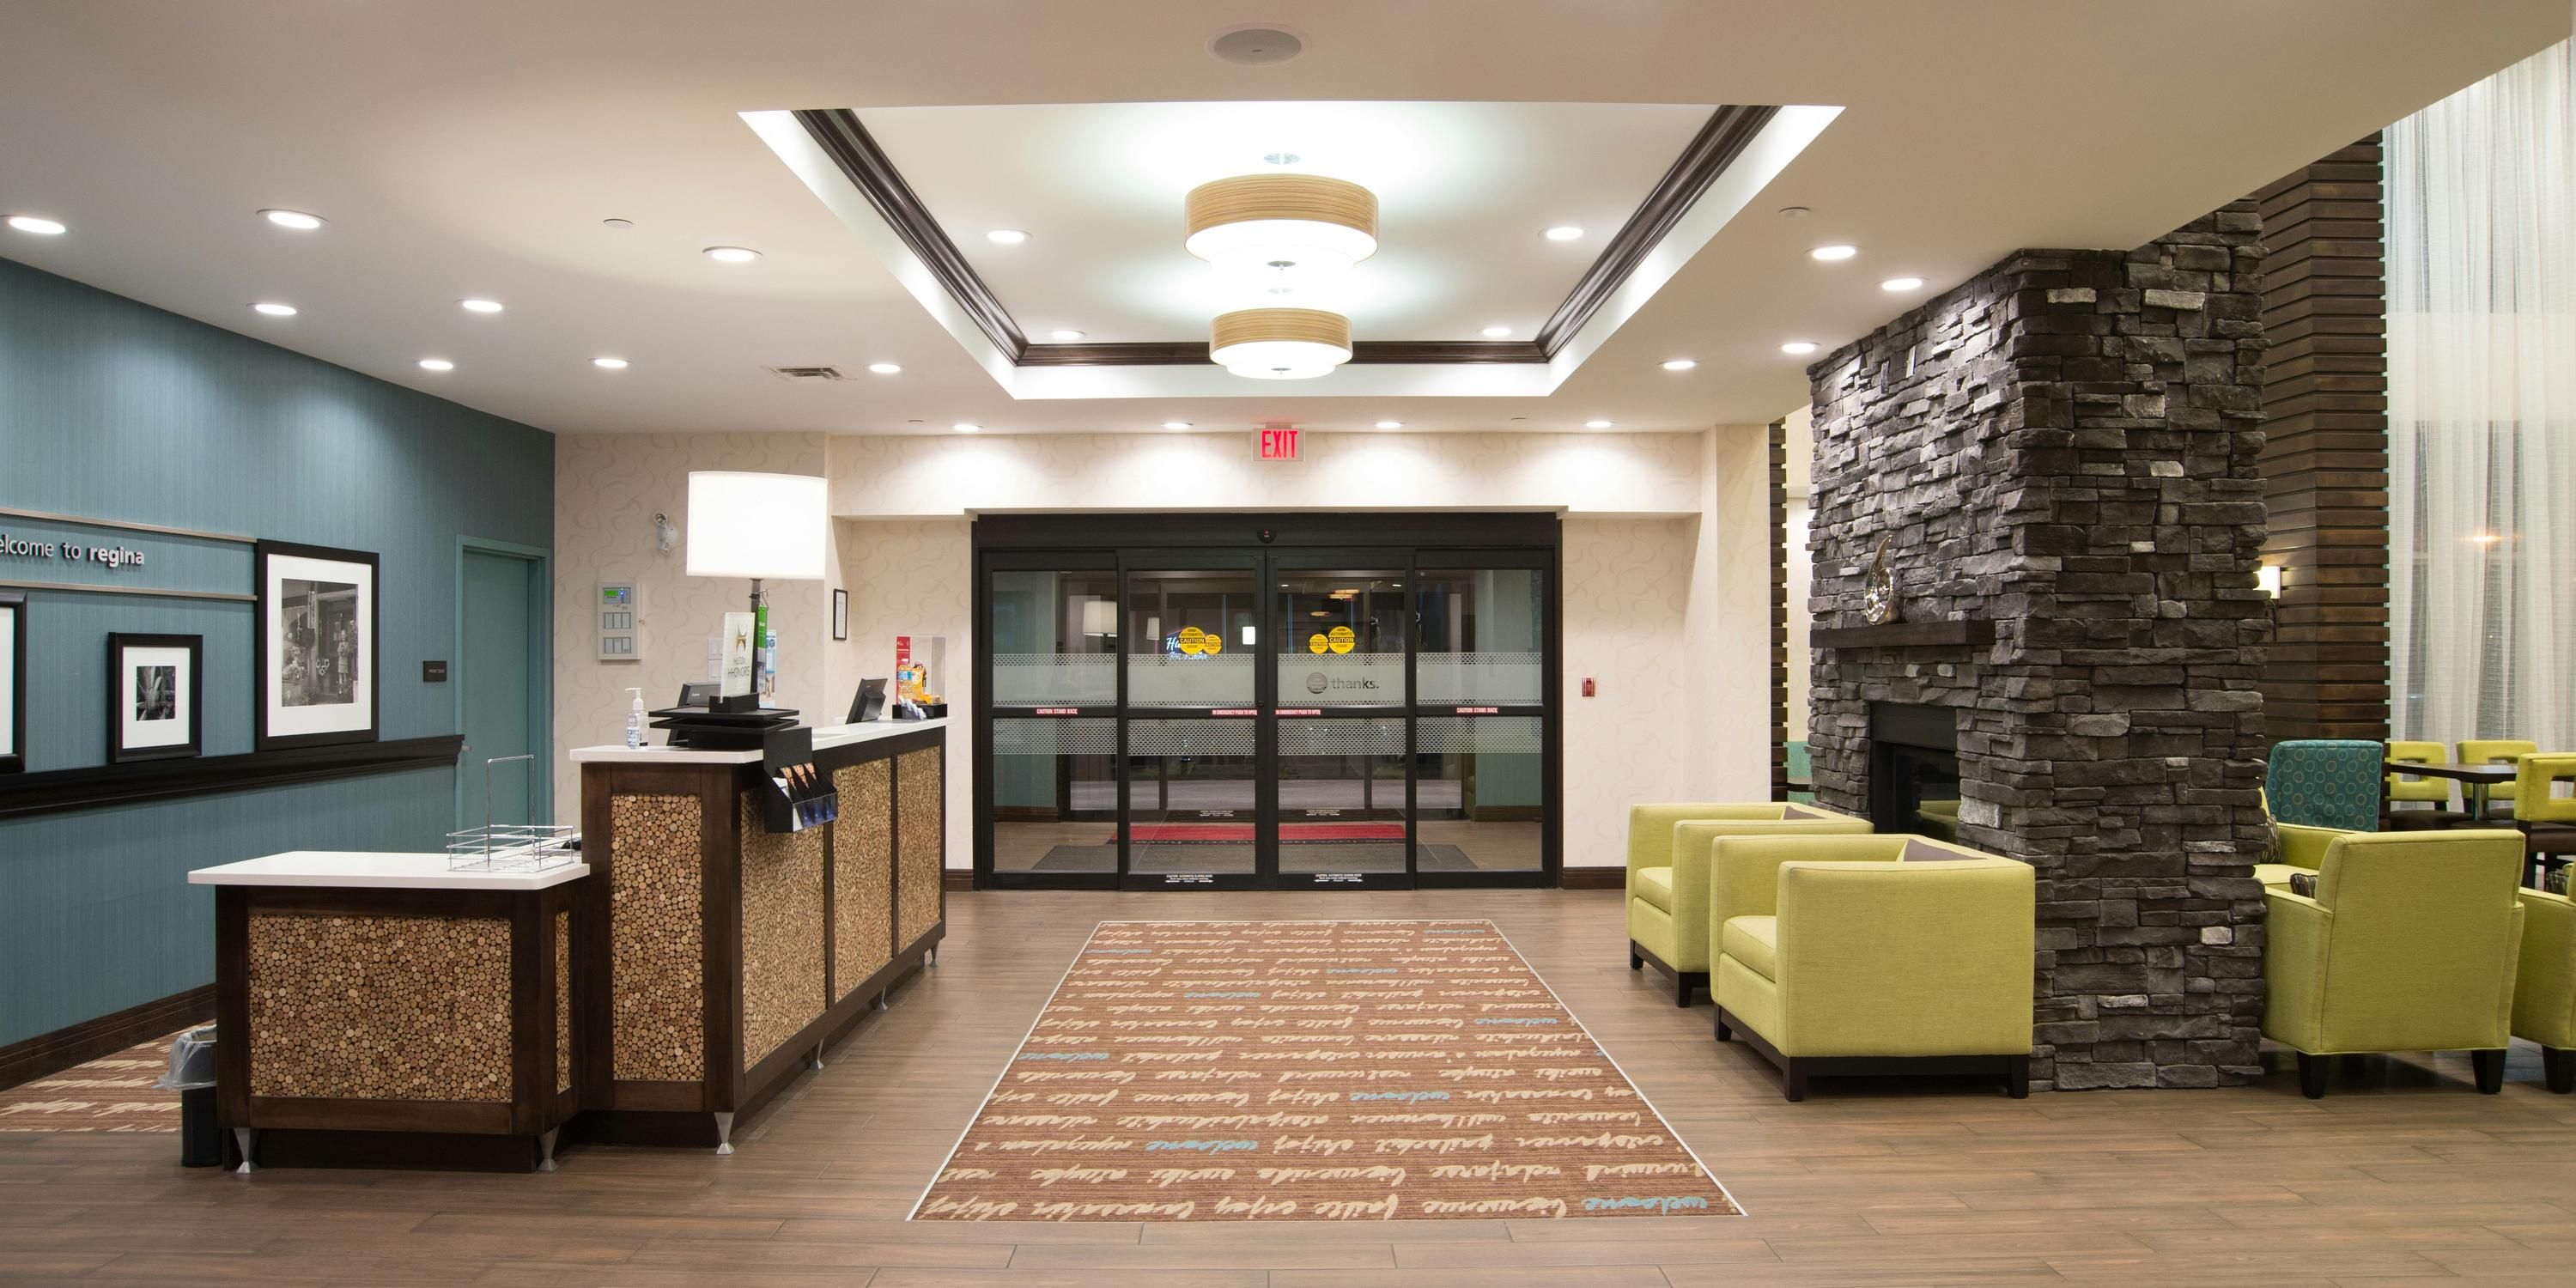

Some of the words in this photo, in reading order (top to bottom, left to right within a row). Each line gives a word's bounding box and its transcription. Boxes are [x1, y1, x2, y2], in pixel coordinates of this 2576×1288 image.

[1261, 430, 1298, 458] EXIT
[0, 534, 54, 557] elcome
[64, 542, 82, 559] to
[89, 546, 144, 568] regina
[727, 665, 750, 677] HHONORS
[1331, 677, 1379, 690] thanks.
[1474, 1018, 1557, 1026] welcome
[1018, 1052, 1109, 1062] welcome
[1349, 1091, 1450, 1104] welcome
[1145, 1139, 1258, 1155] welcome
[1580, 1196, 1706, 1213] welcome
